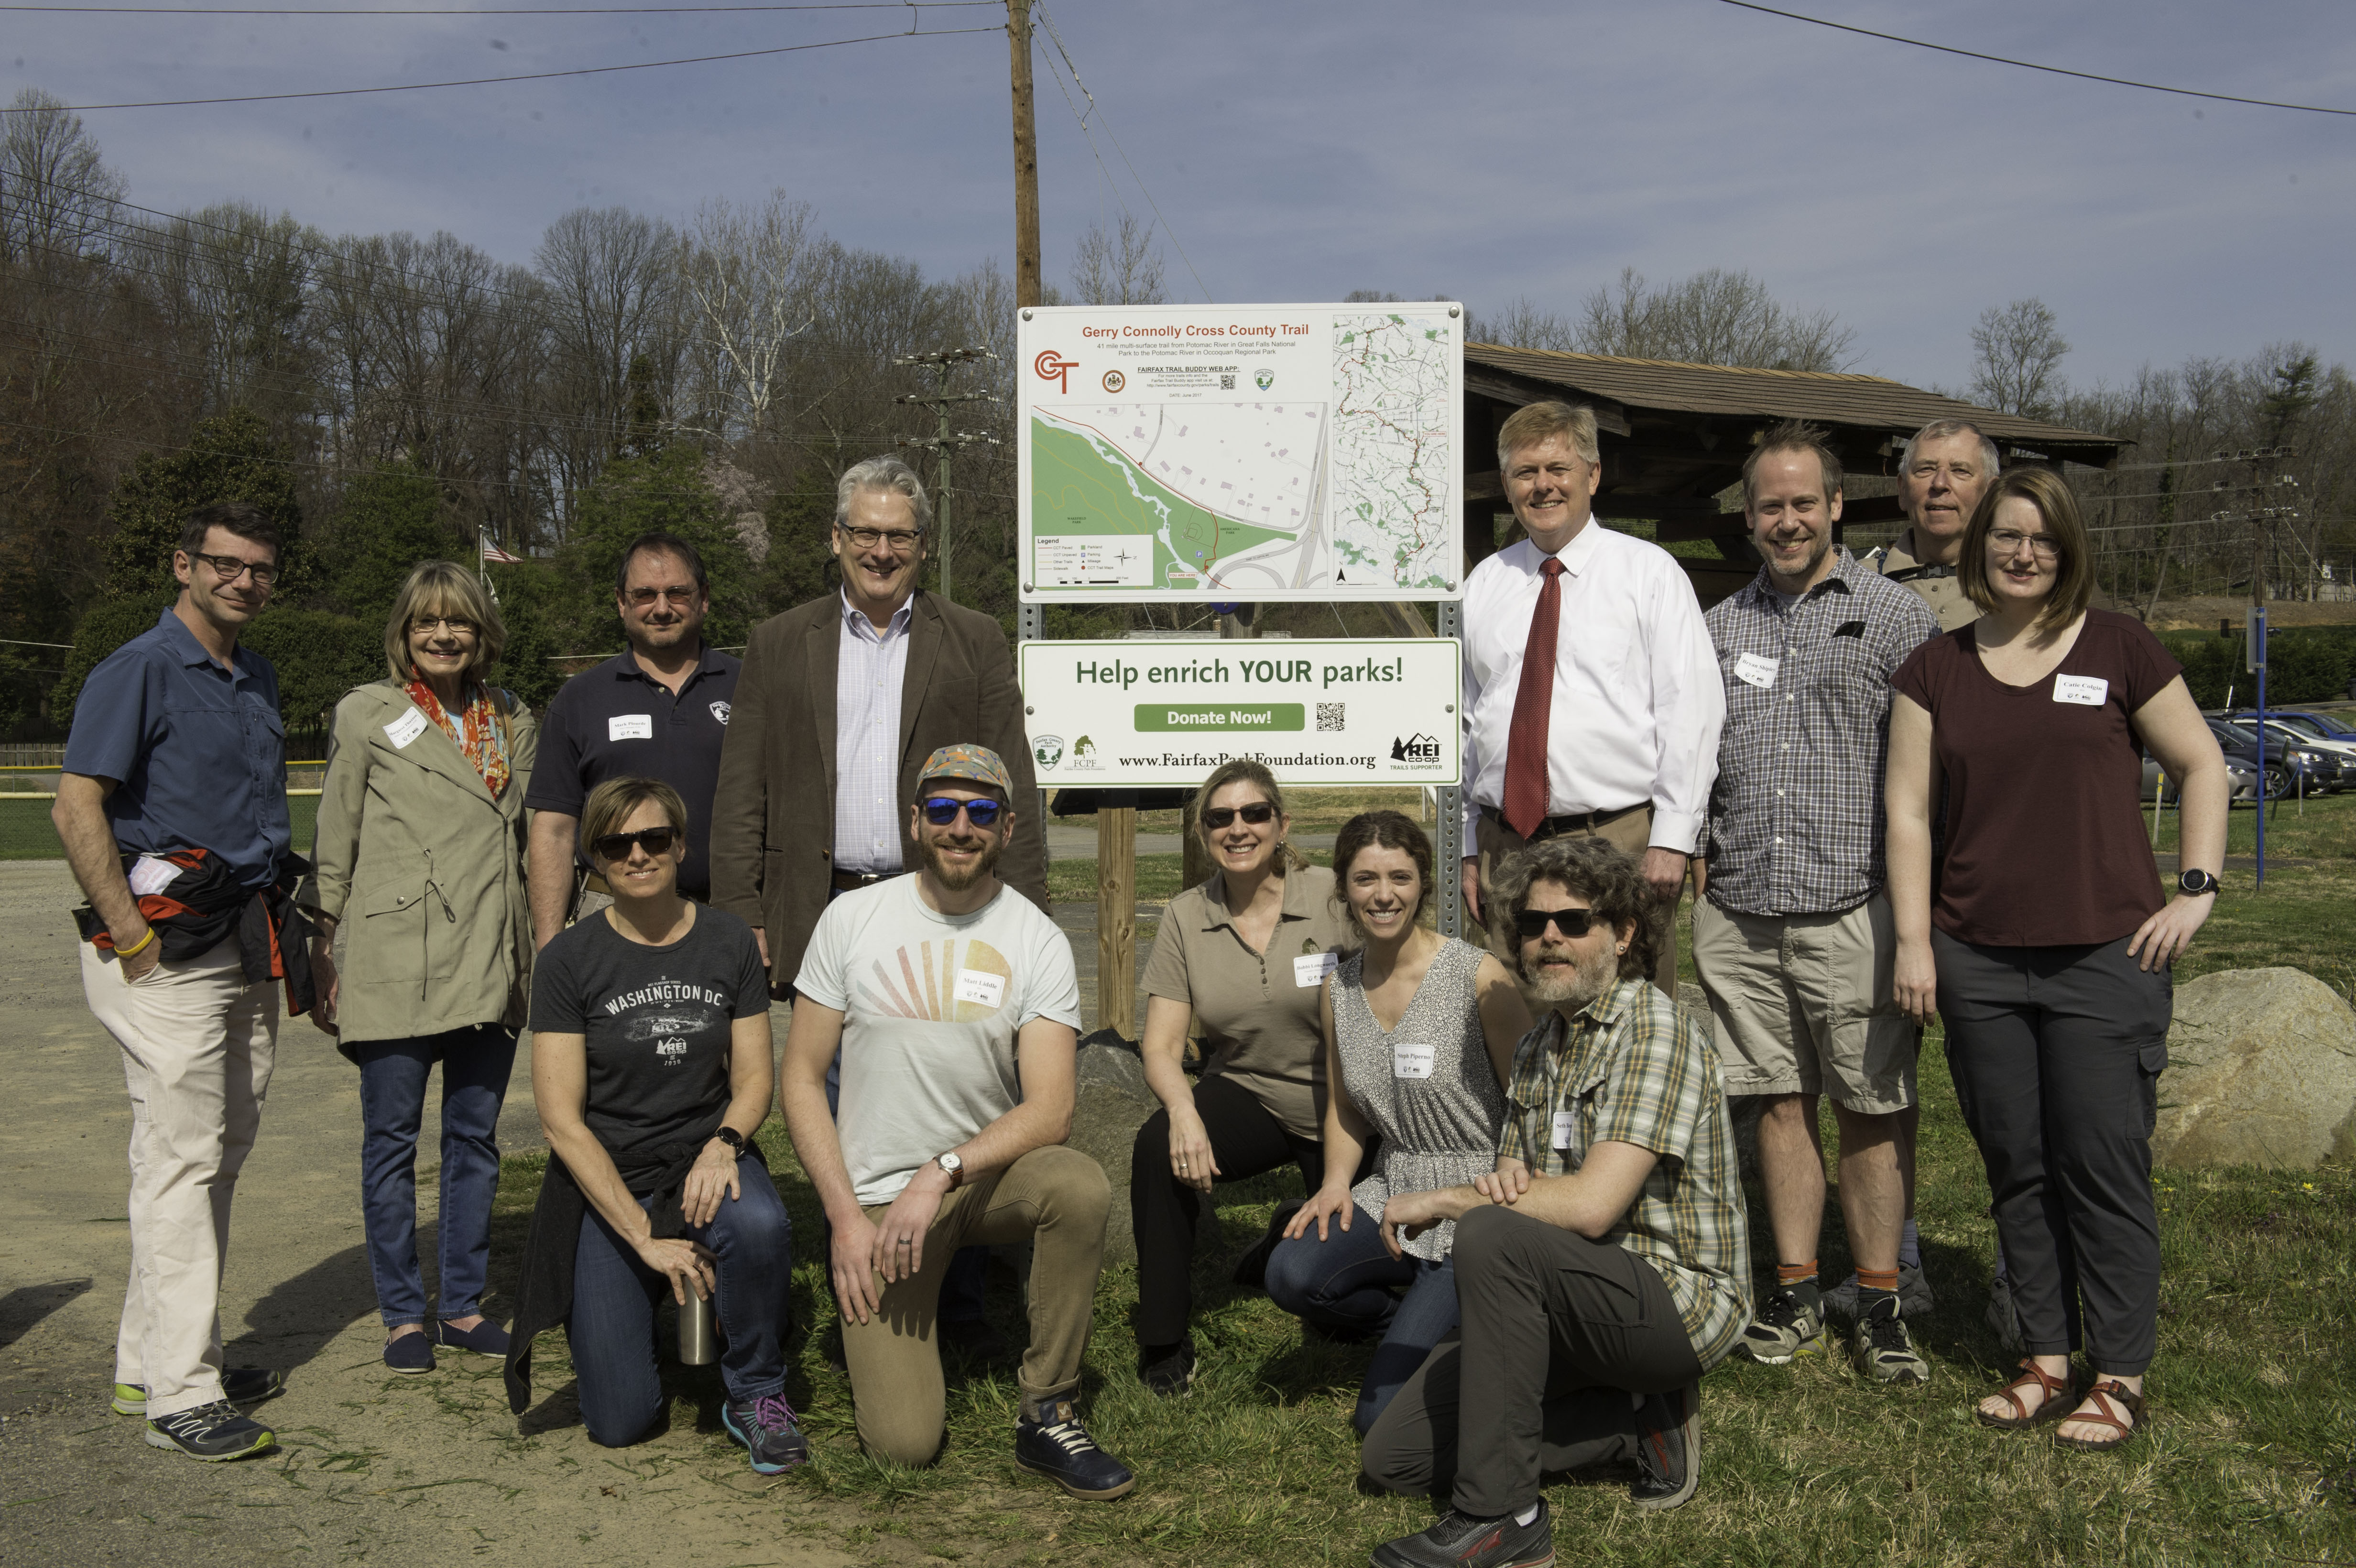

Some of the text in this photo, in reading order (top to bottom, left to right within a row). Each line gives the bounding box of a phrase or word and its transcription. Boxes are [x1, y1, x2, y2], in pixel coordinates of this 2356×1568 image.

[1082, 324, 1309, 339] Gerry Connolly Cross County Trail
[1743, 659, 1775, 673] Bryan Shipley
[1077, 657, 1403, 690] Help enrich YOUR parks!
[1167, 710, 1272, 724] Donate Now!
[1408, 744, 1439, 756] REI
[979, 980, 997, 989] Liddle
[605, 985, 723, 1015] WASHINGTON DC
[667, 1042, 687, 1051] REI
